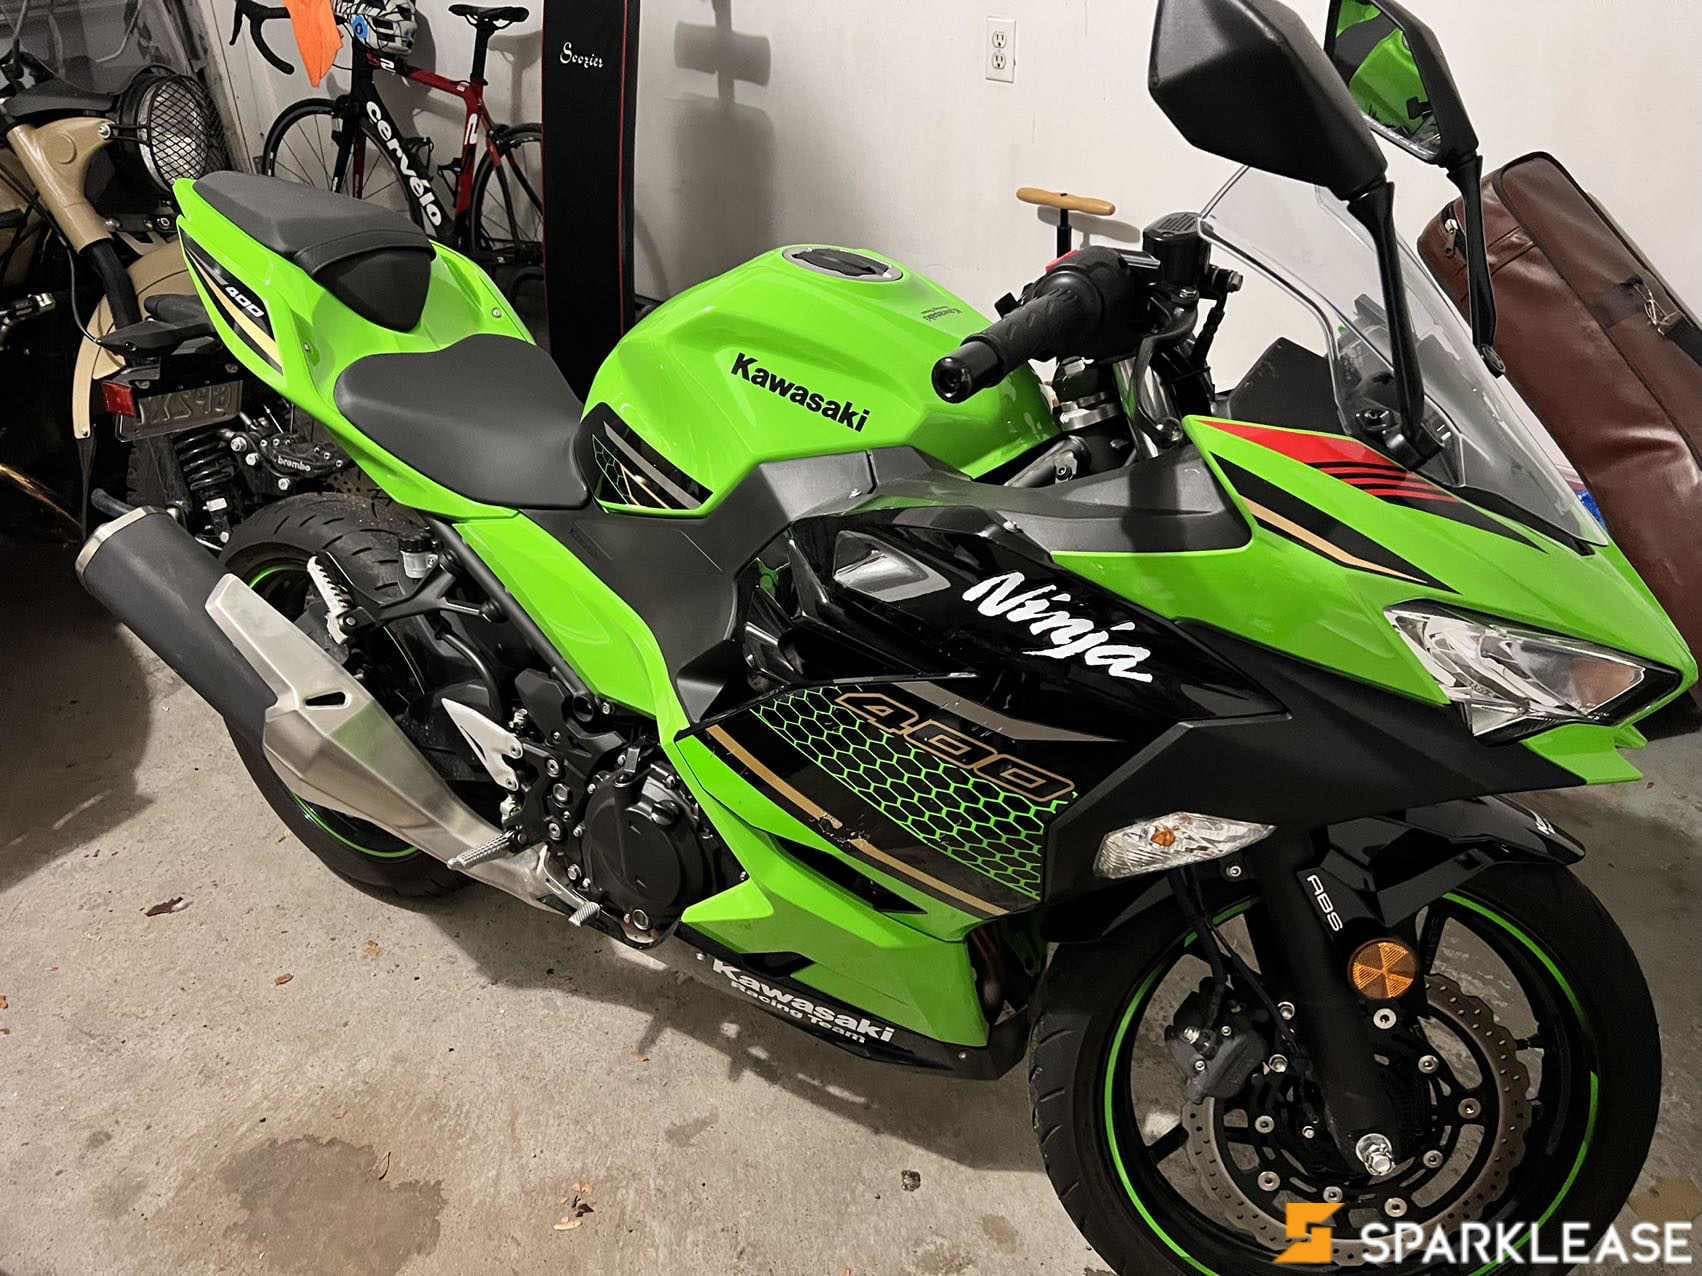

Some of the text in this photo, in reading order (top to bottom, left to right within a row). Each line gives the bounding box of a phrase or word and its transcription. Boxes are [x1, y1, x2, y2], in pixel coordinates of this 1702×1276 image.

[225, 286, 265, 318] 400
[730, 351, 871, 433] Kawasaki
[277, 455, 311, 472] brembo
[962, 571, 1153, 683] Ninja
[835, 692, 1076, 802] 400
[1306, 874, 1344, 932] ABS
[712, 958, 896, 1043] Kawasaki
[808, 1014, 866, 1044] Team
